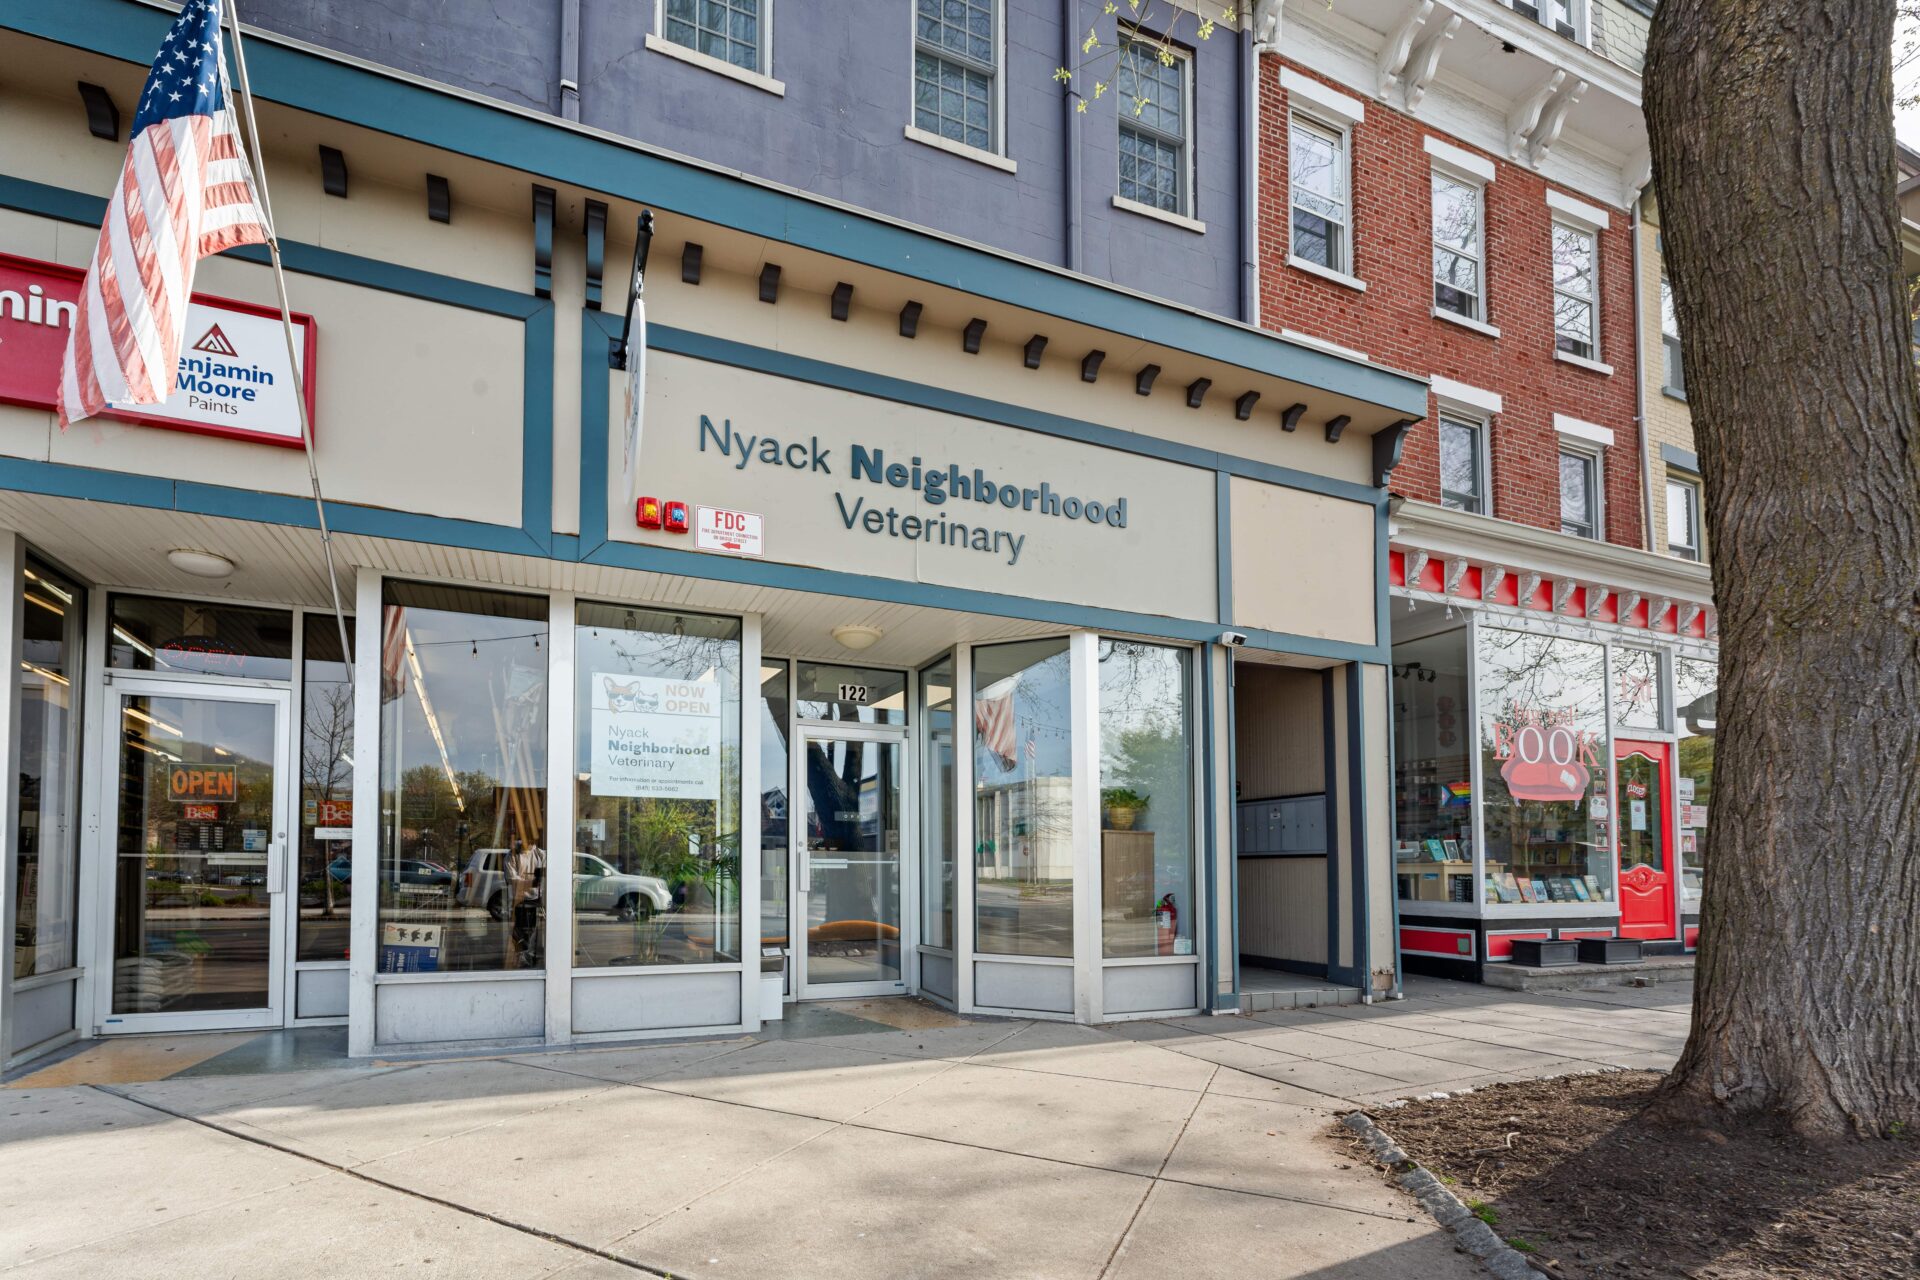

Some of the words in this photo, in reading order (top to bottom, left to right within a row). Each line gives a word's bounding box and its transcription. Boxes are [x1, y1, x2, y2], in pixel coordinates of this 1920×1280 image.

[178, 356, 274, 386] enjamin
[175, 372, 256, 402] Moore
[189, 395, 238, 415] Paints
[699, 414, 832, 475] Nyack
[851, 443, 1128, 529] Neighborhood
[715, 511, 746, 531] FDC
[835, 492, 1026, 566] Veterinary
[163, 643, 247, 668] OPEN
[665, 684, 706, 699] NOW
[840, 685, 866, 701] 122
[665, 700, 711, 714] OPEN
[1513, 699, 1542, 725] big
[608, 724, 649, 740] Nyack
[608, 740, 711, 756] Neighborhood
[608, 754, 675, 772] Veterinary
[172, 769, 234, 796] OPEN
[185, 806, 218, 820] Best
[321, 804, 353, 821] Be
